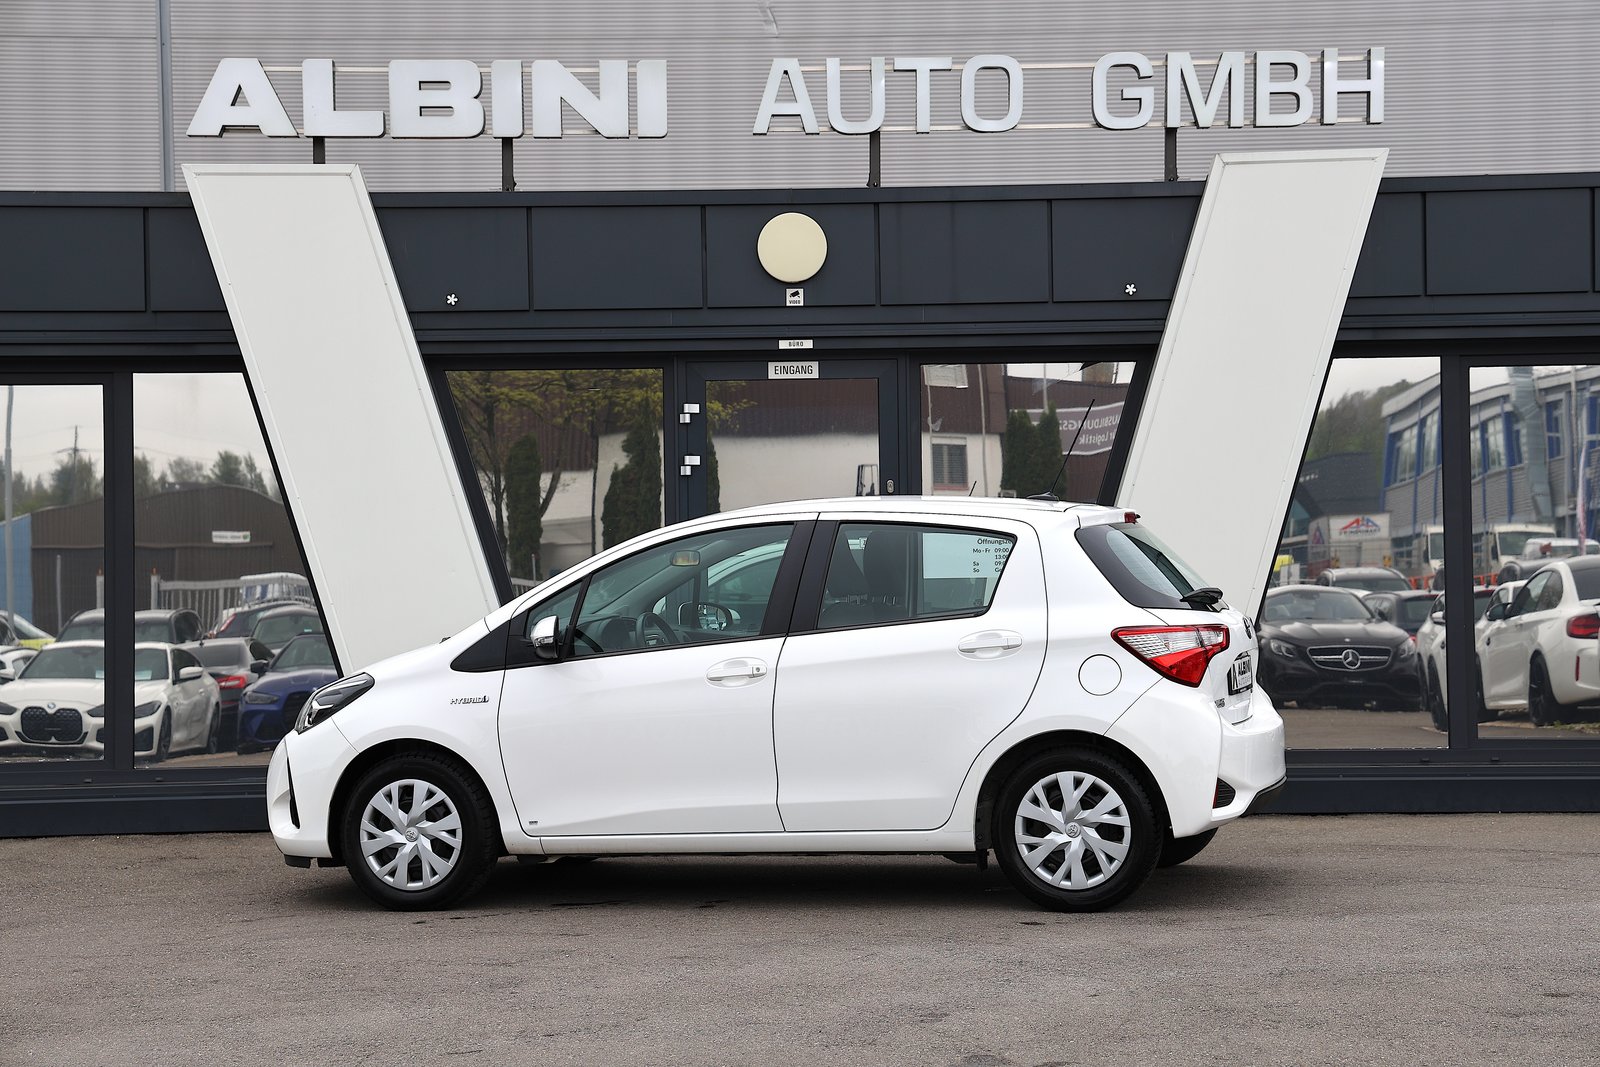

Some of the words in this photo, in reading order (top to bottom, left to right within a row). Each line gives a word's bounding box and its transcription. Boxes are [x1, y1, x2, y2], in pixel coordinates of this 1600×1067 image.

[186, 57, 668, 139] ALBINI
[752, 53, 1024, 135] AUTO
[1092, 46, 1386, 130] GMBH
[774, 364, 813, 375] EINGANG
